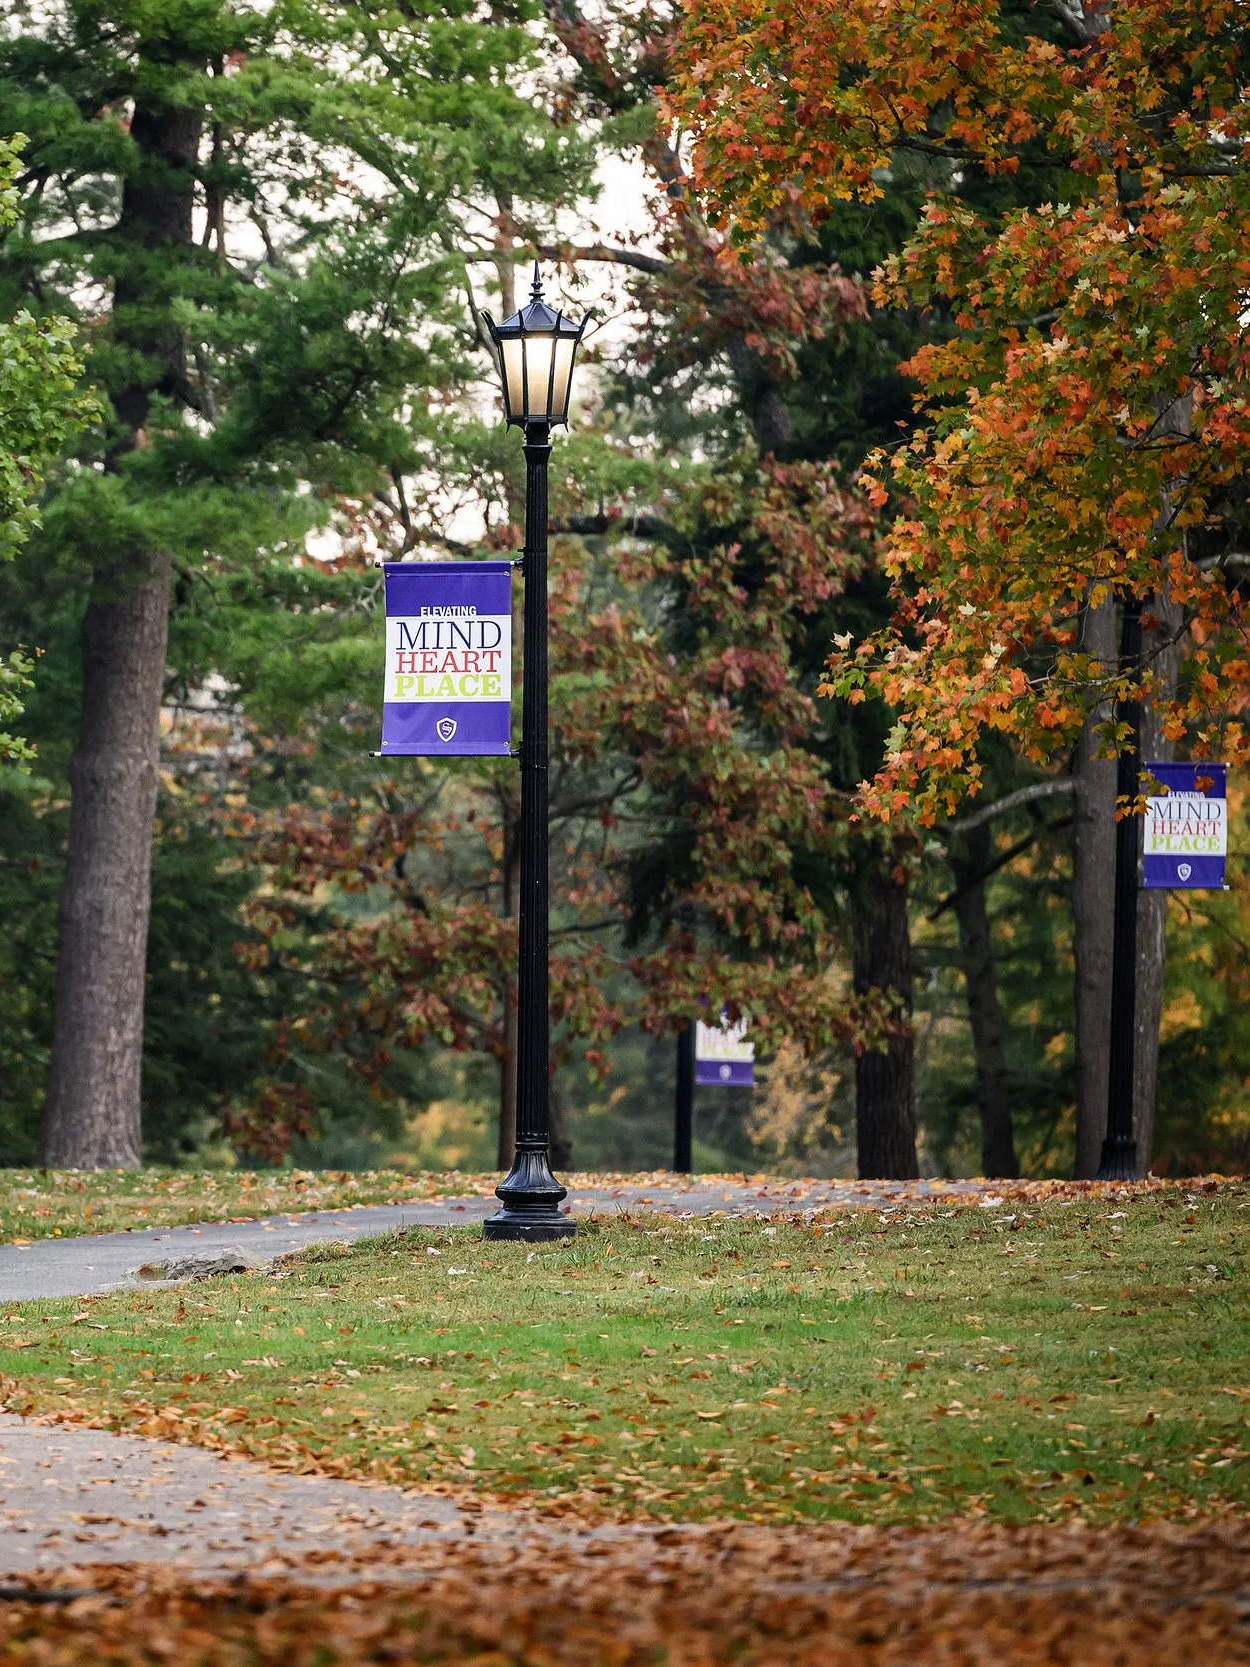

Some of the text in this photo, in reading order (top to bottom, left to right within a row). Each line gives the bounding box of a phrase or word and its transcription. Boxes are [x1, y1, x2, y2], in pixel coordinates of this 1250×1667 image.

[421, 606, 477, 617] ELEVATING
[396, 621, 502, 650] MIND
[395, 651, 501, 674] HEART
[394, 674, 501, 697] PLACE
[1153, 801, 1221, 820] MIND
[1152, 820, 1221, 835] HEART
[1151, 835, 1220, 851] PLACE
